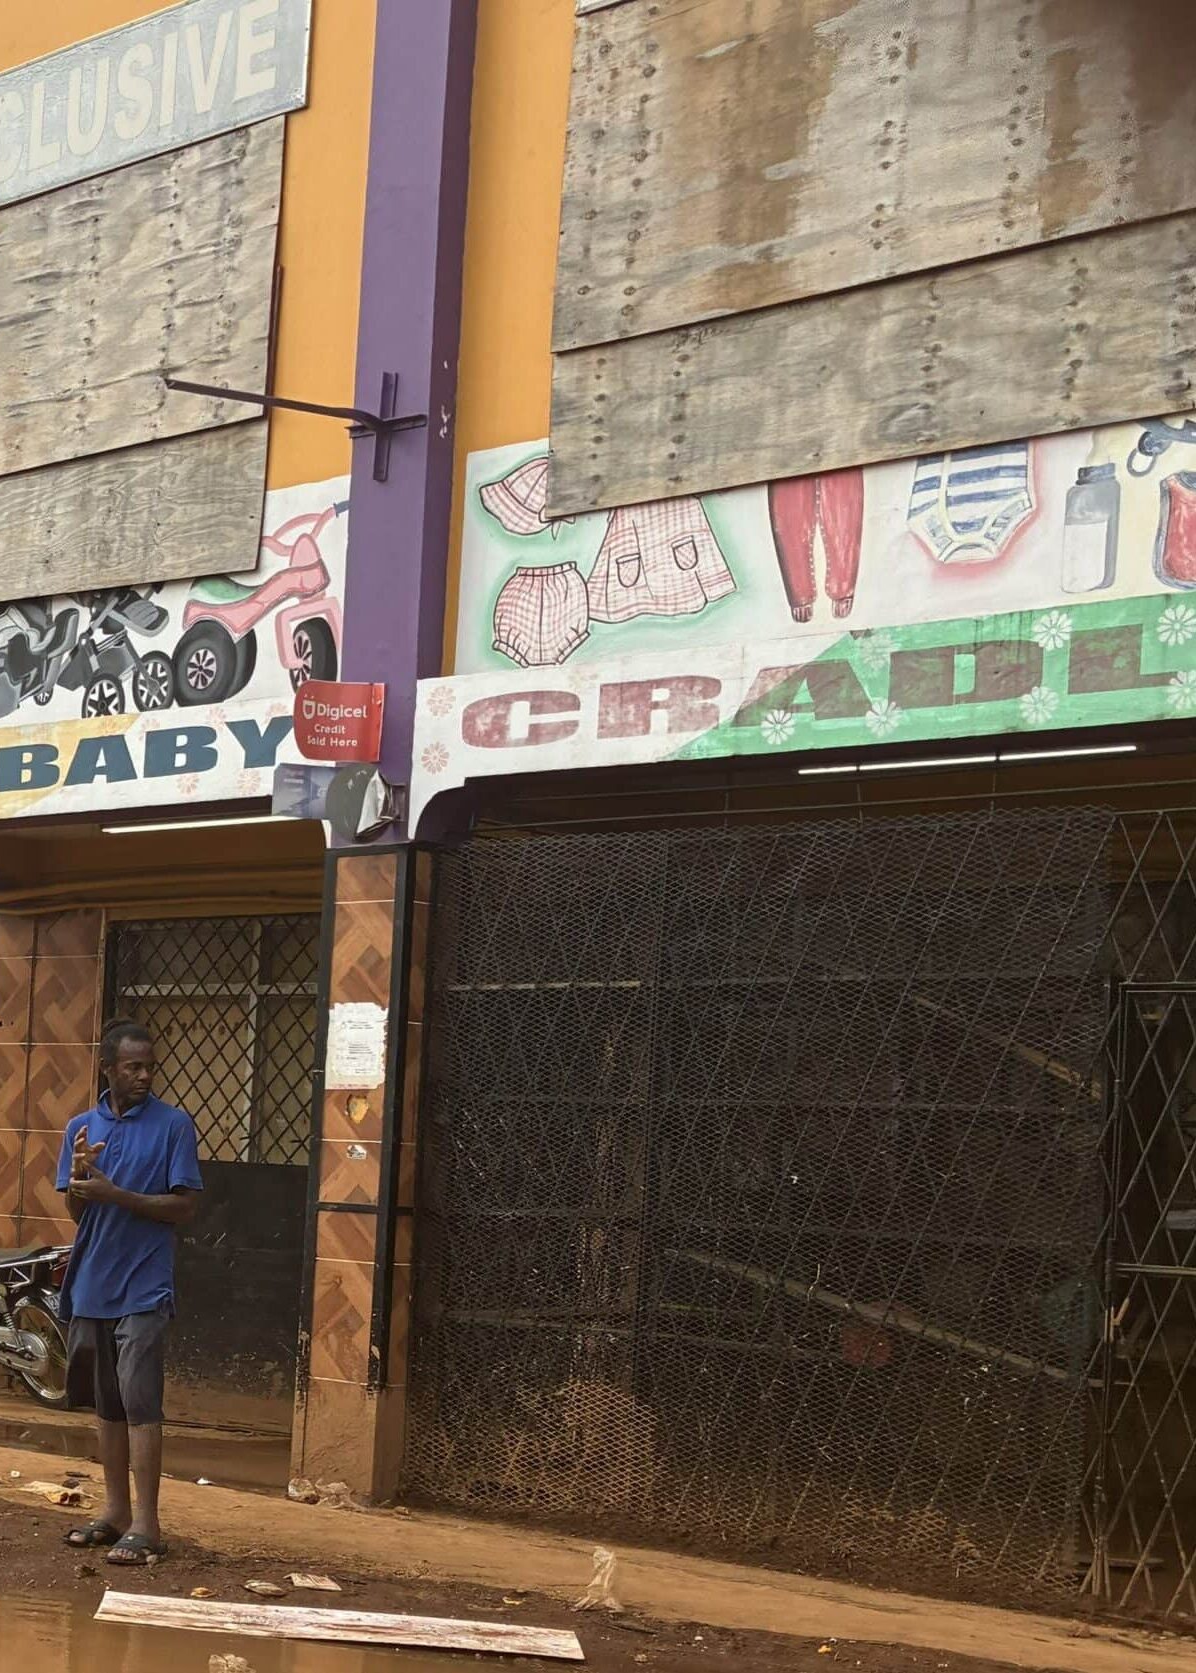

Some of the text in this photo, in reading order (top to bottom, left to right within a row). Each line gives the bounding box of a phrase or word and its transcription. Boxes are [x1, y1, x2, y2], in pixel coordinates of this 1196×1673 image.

[317, 703, 367, 720] Digicel
[314, 724, 346, 735] Credit
[307, 735, 358, 747] Sold Here
